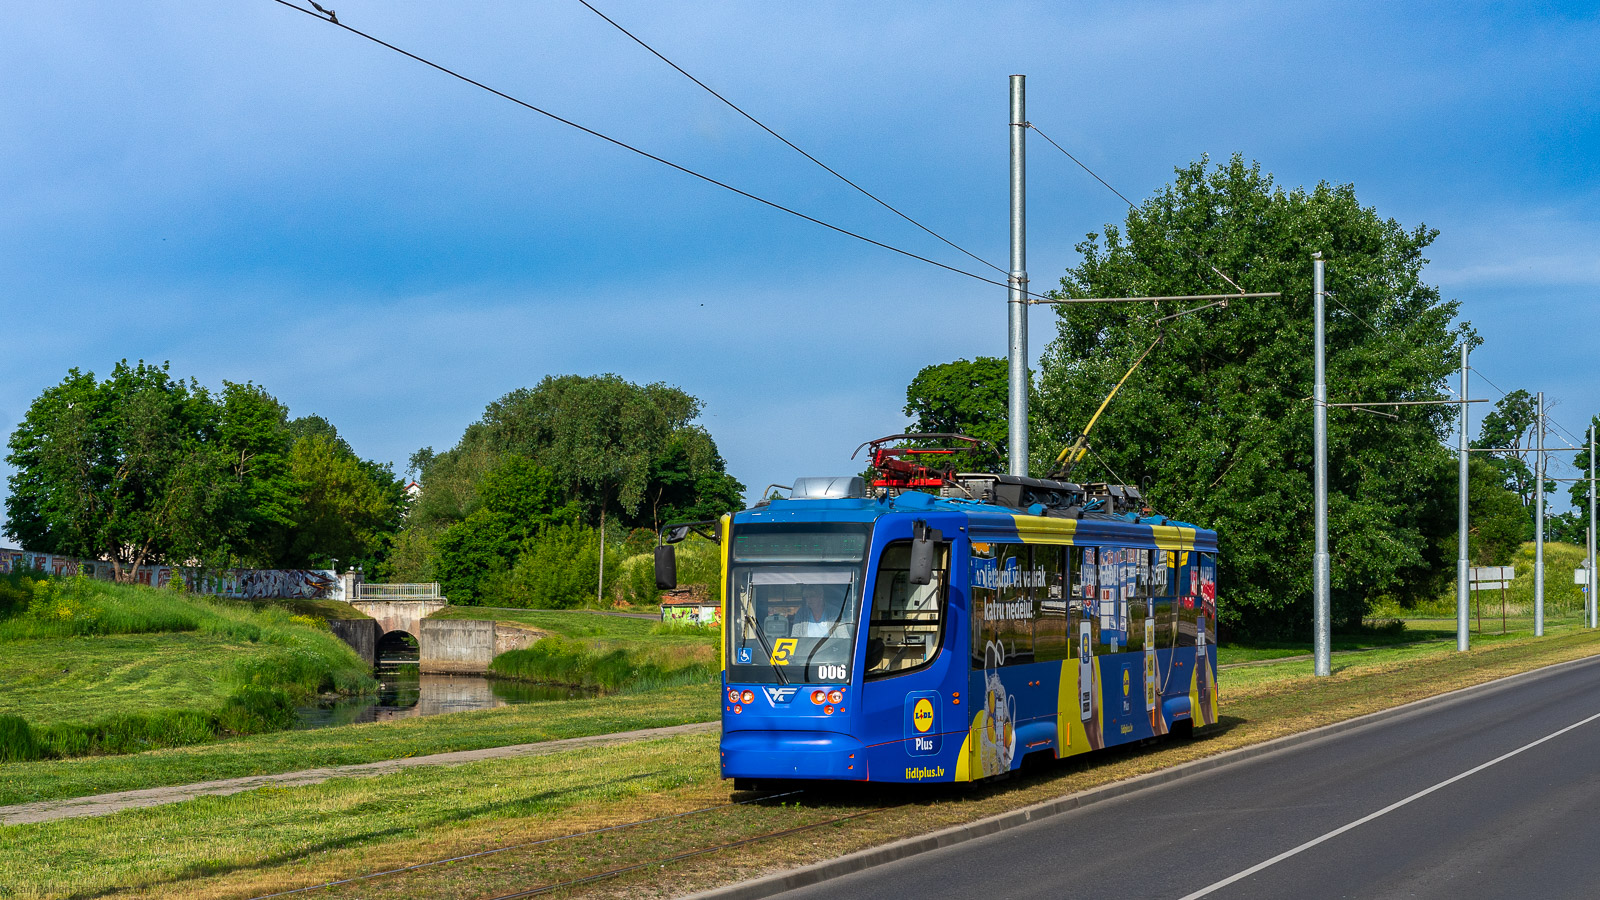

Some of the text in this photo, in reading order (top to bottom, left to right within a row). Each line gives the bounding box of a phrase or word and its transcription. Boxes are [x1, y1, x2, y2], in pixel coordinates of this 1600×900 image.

[984, 596, 1005, 621] katru
[774, 642, 793, 661] 5
[818, 664, 846, 680] 006
[915, 738, 933, 751] Plus
[905, 766, 945, 781] lidlplus.lv
